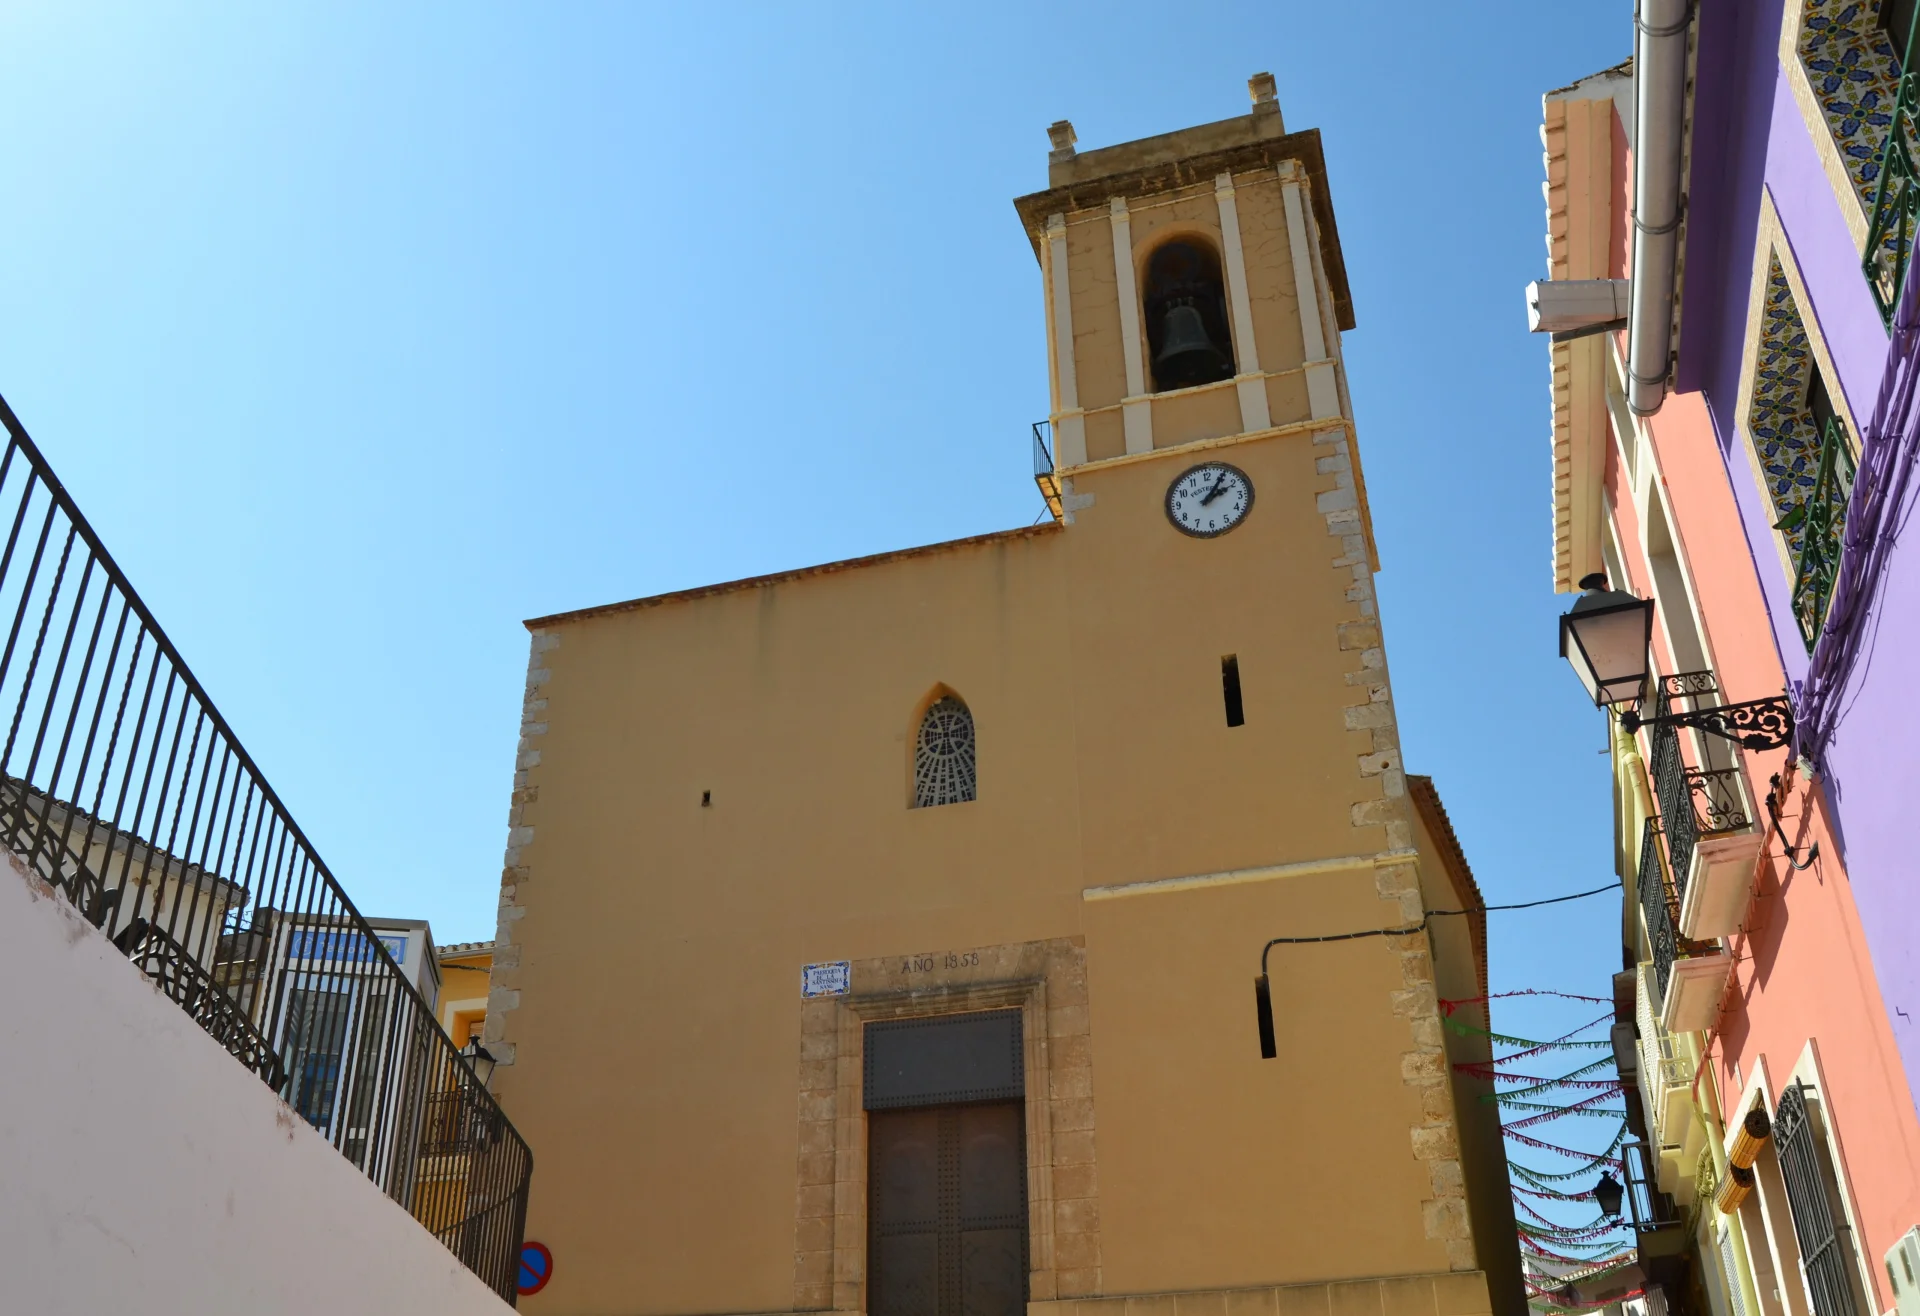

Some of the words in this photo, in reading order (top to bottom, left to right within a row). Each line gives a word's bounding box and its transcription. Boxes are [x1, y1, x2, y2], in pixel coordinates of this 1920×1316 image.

[1203, 472, 1212, 482] 12
[1189, 478, 1197, 488] 11
[1230, 479, 1236, 488] 2
[1179, 488, 1188, 498] 10
[1237, 490, 1243, 500] 3
[1175, 501, 1182, 510] 9
[1233, 502, 1240, 511] 4
[1182, 512, 1188, 521] 8
[1223, 514, 1230, 523] 5
[1194, 518, 1201, 528] 7
[1209, 519, 1215, 529] 6
[944, 952, 979, 970] 1858
